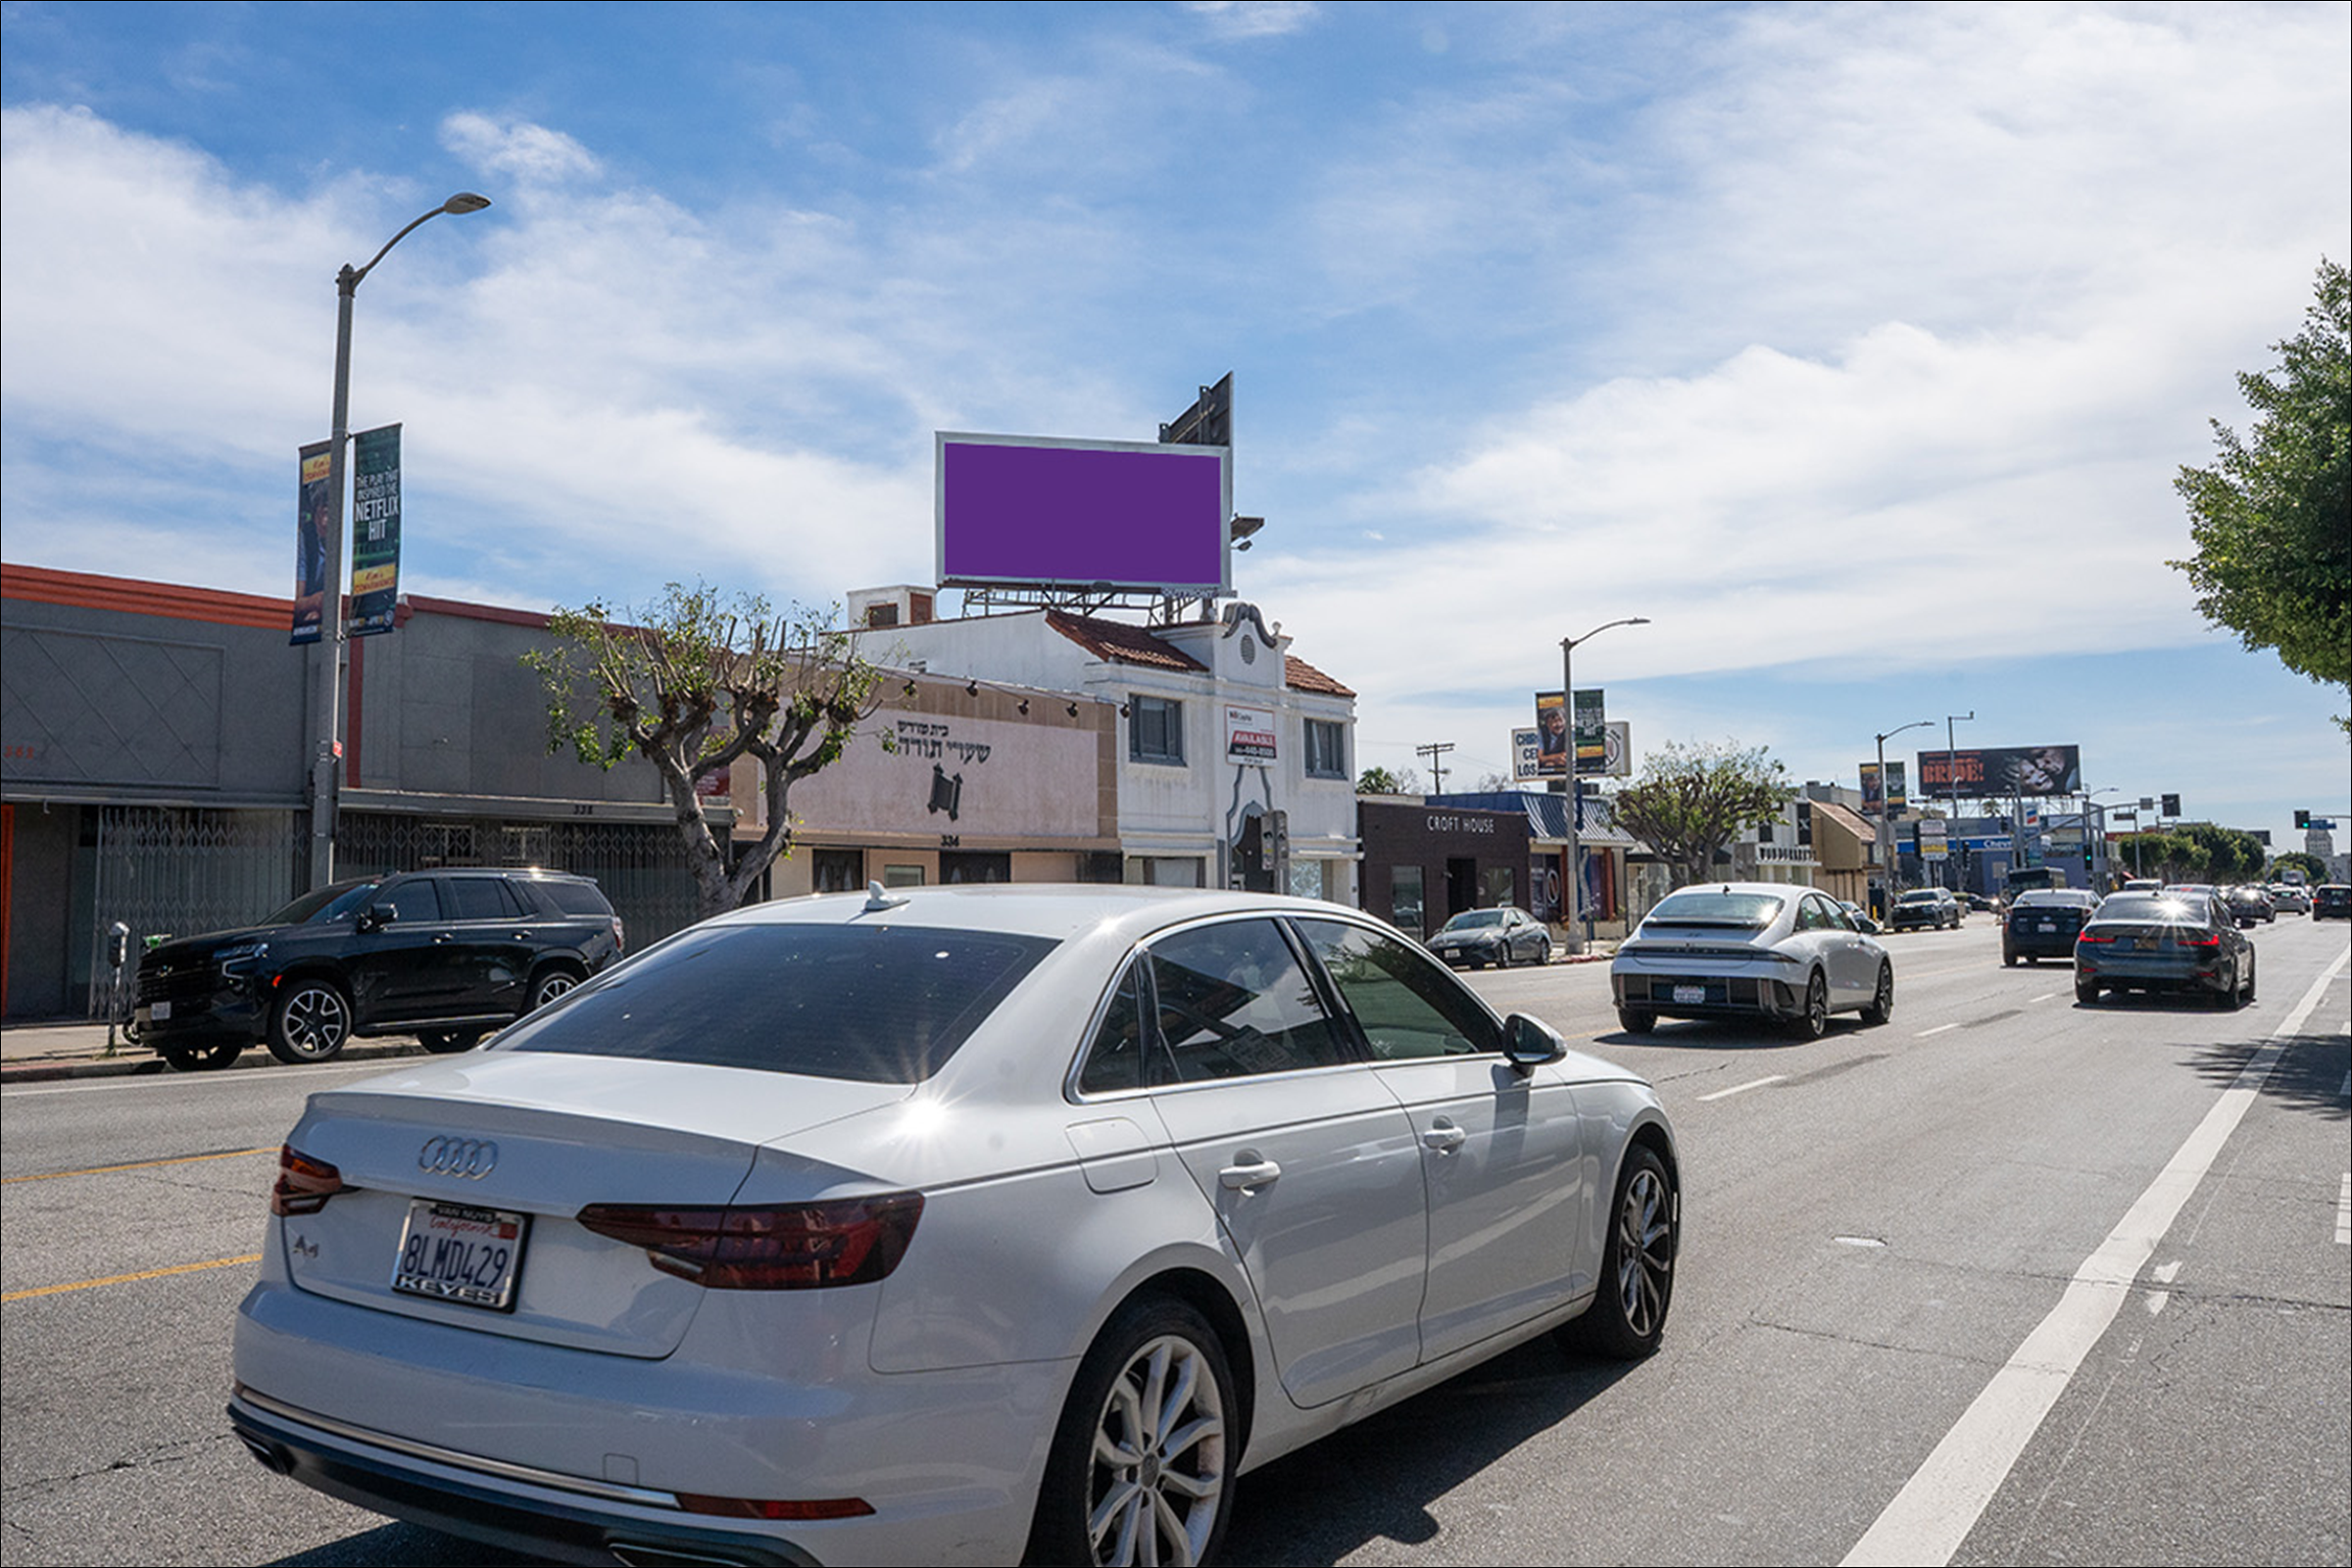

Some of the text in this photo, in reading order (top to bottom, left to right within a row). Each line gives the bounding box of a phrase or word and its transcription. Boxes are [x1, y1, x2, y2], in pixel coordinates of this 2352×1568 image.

[356, 495, 399, 522] NETFLIX
[368, 518, 387, 541] HIT
[1234, 732, 1273, 746] AVAILABLE
[1516, 733, 1539, 746] CHIR
[1523, 748, 1539, 760] CE
[1517, 764, 1537, 776] LOS
[1923, 762, 1984, 783] BRIDE!
[1427, 815, 1494, 834] CROFT HOUSE
[292, 1234, 319, 1259] A4
[403, 1234, 509, 1290] 8LMD429
[399, 1275, 497, 1304] KEYES
